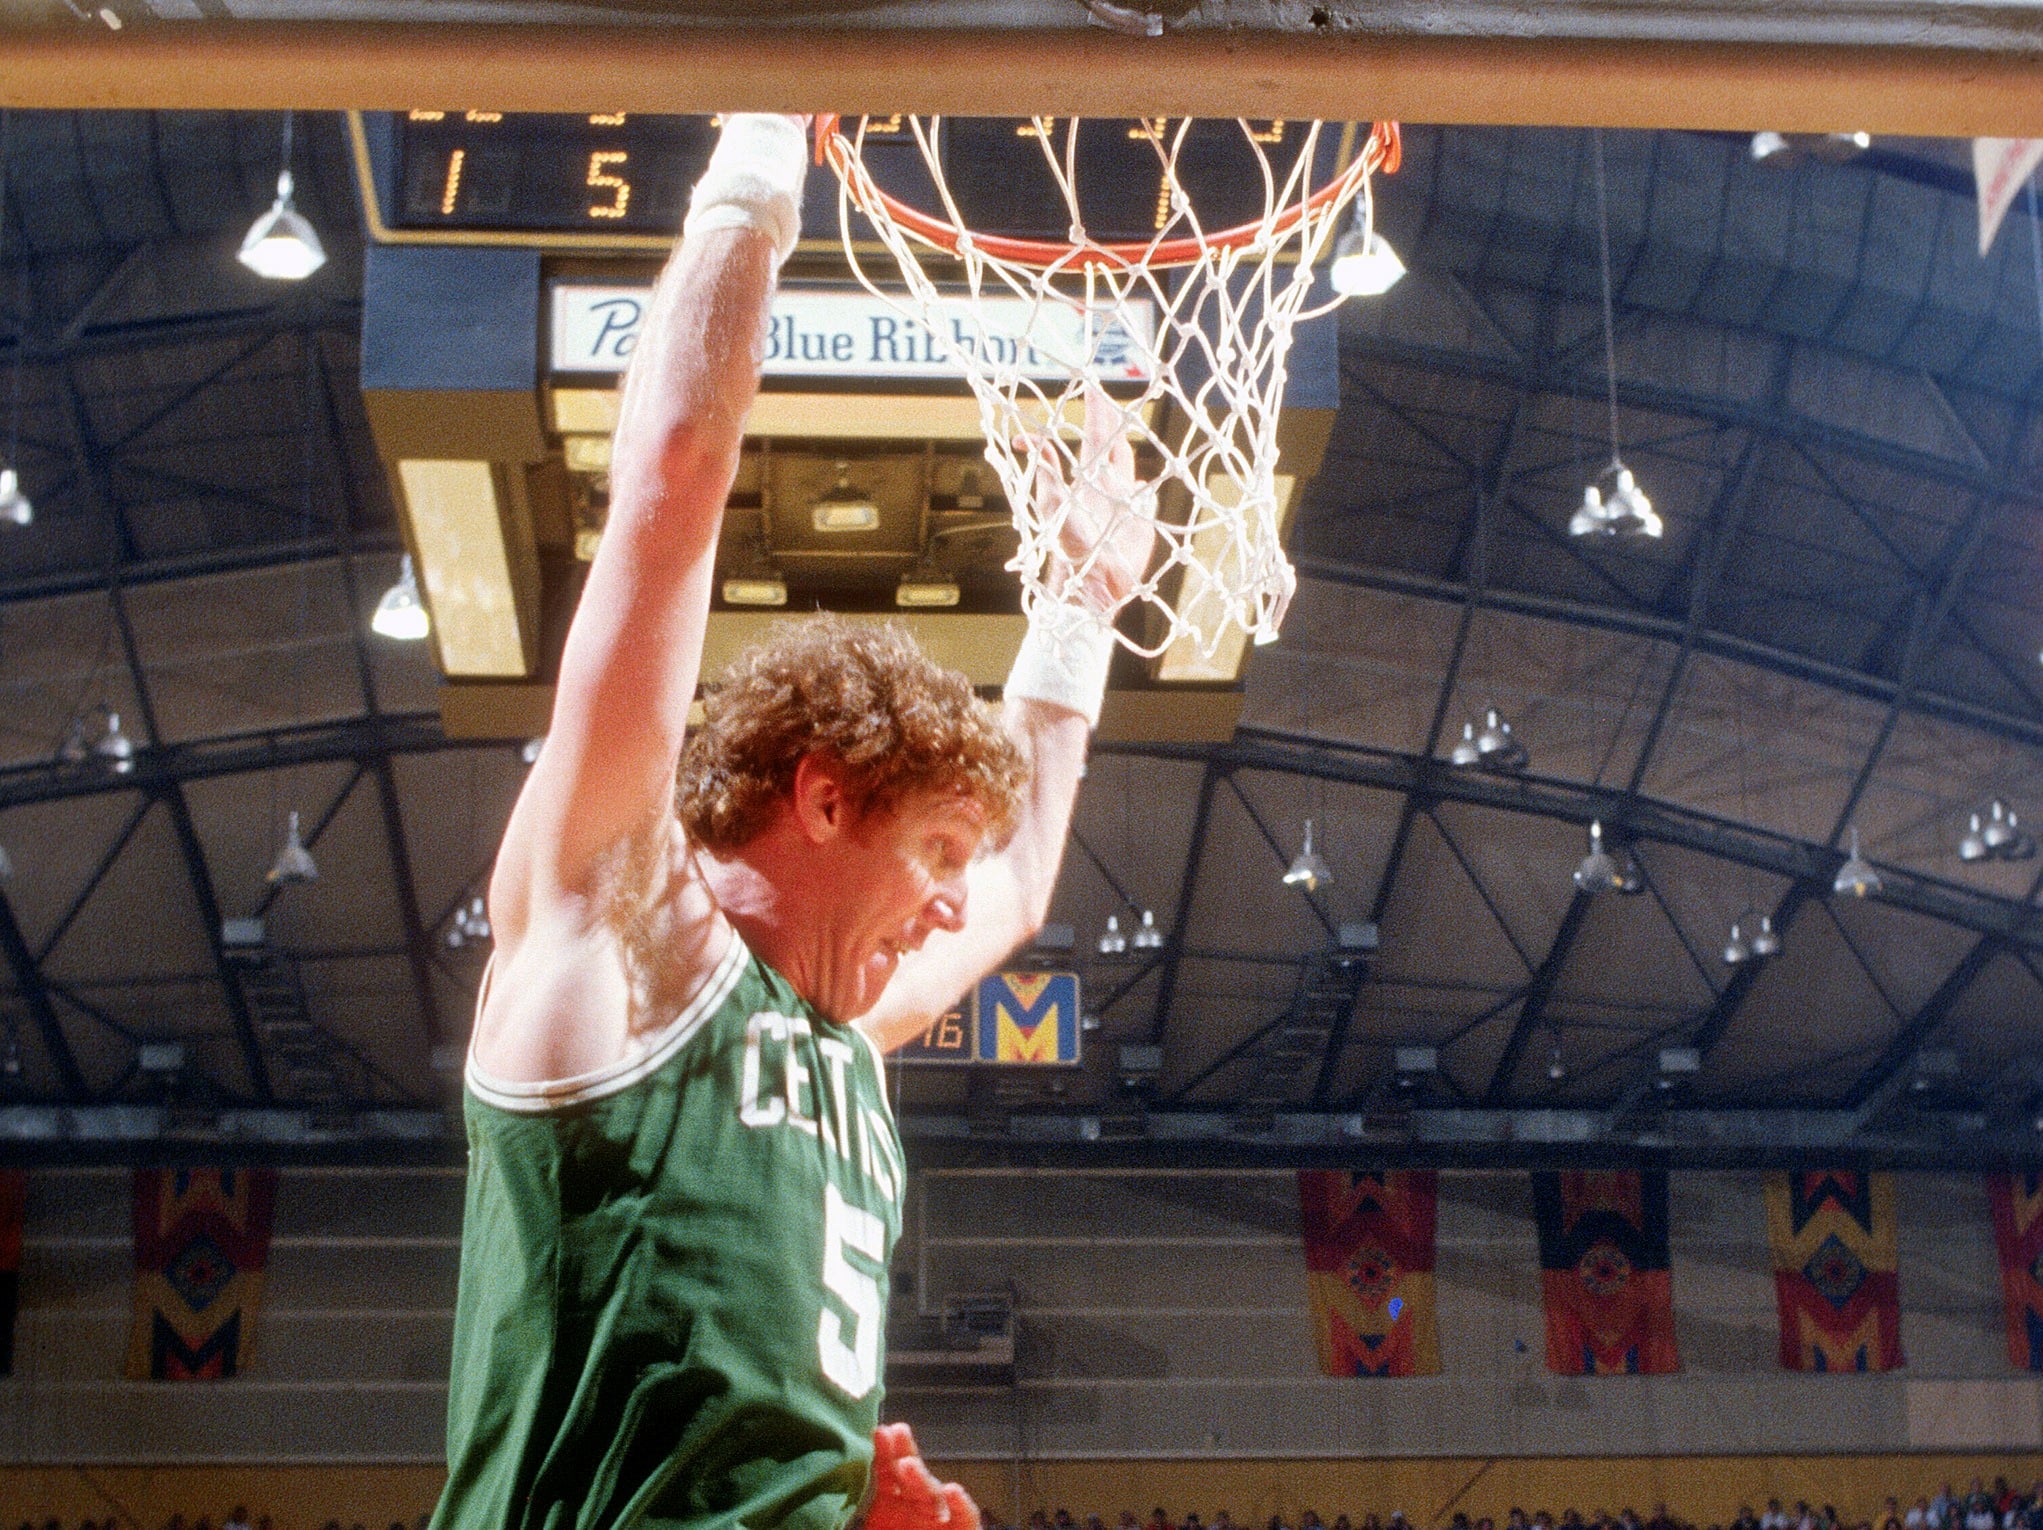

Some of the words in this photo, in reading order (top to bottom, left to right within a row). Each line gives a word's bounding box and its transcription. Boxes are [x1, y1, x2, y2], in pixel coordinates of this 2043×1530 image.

[587, 151, 630, 218] 5
[765, 315, 854, 361] Blue
[817, 1182, 885, 1400] 5
